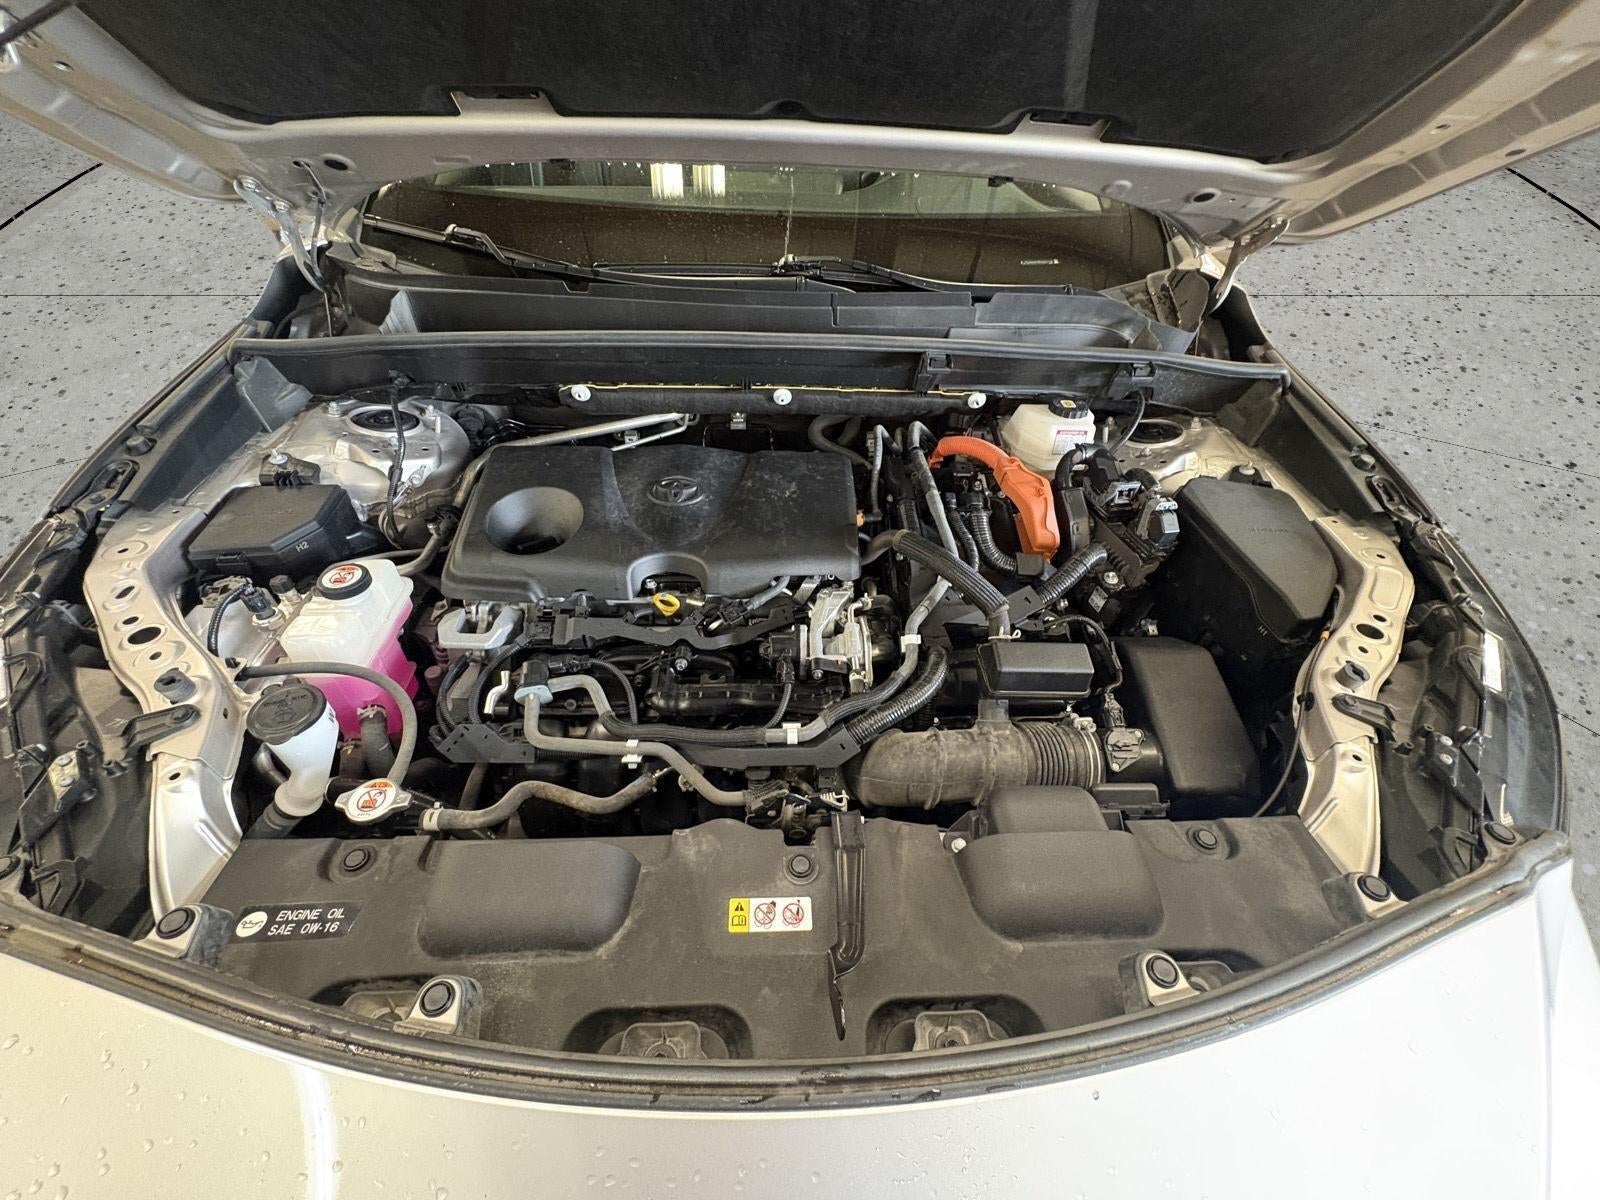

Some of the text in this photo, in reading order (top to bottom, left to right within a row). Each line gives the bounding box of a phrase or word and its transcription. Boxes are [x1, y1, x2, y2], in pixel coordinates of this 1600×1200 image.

[295, 541, 310, 552] H2
[275, 908, 345, 921] ENGINE OIL
[267, 922, 340, 936] SAE 0W-16
